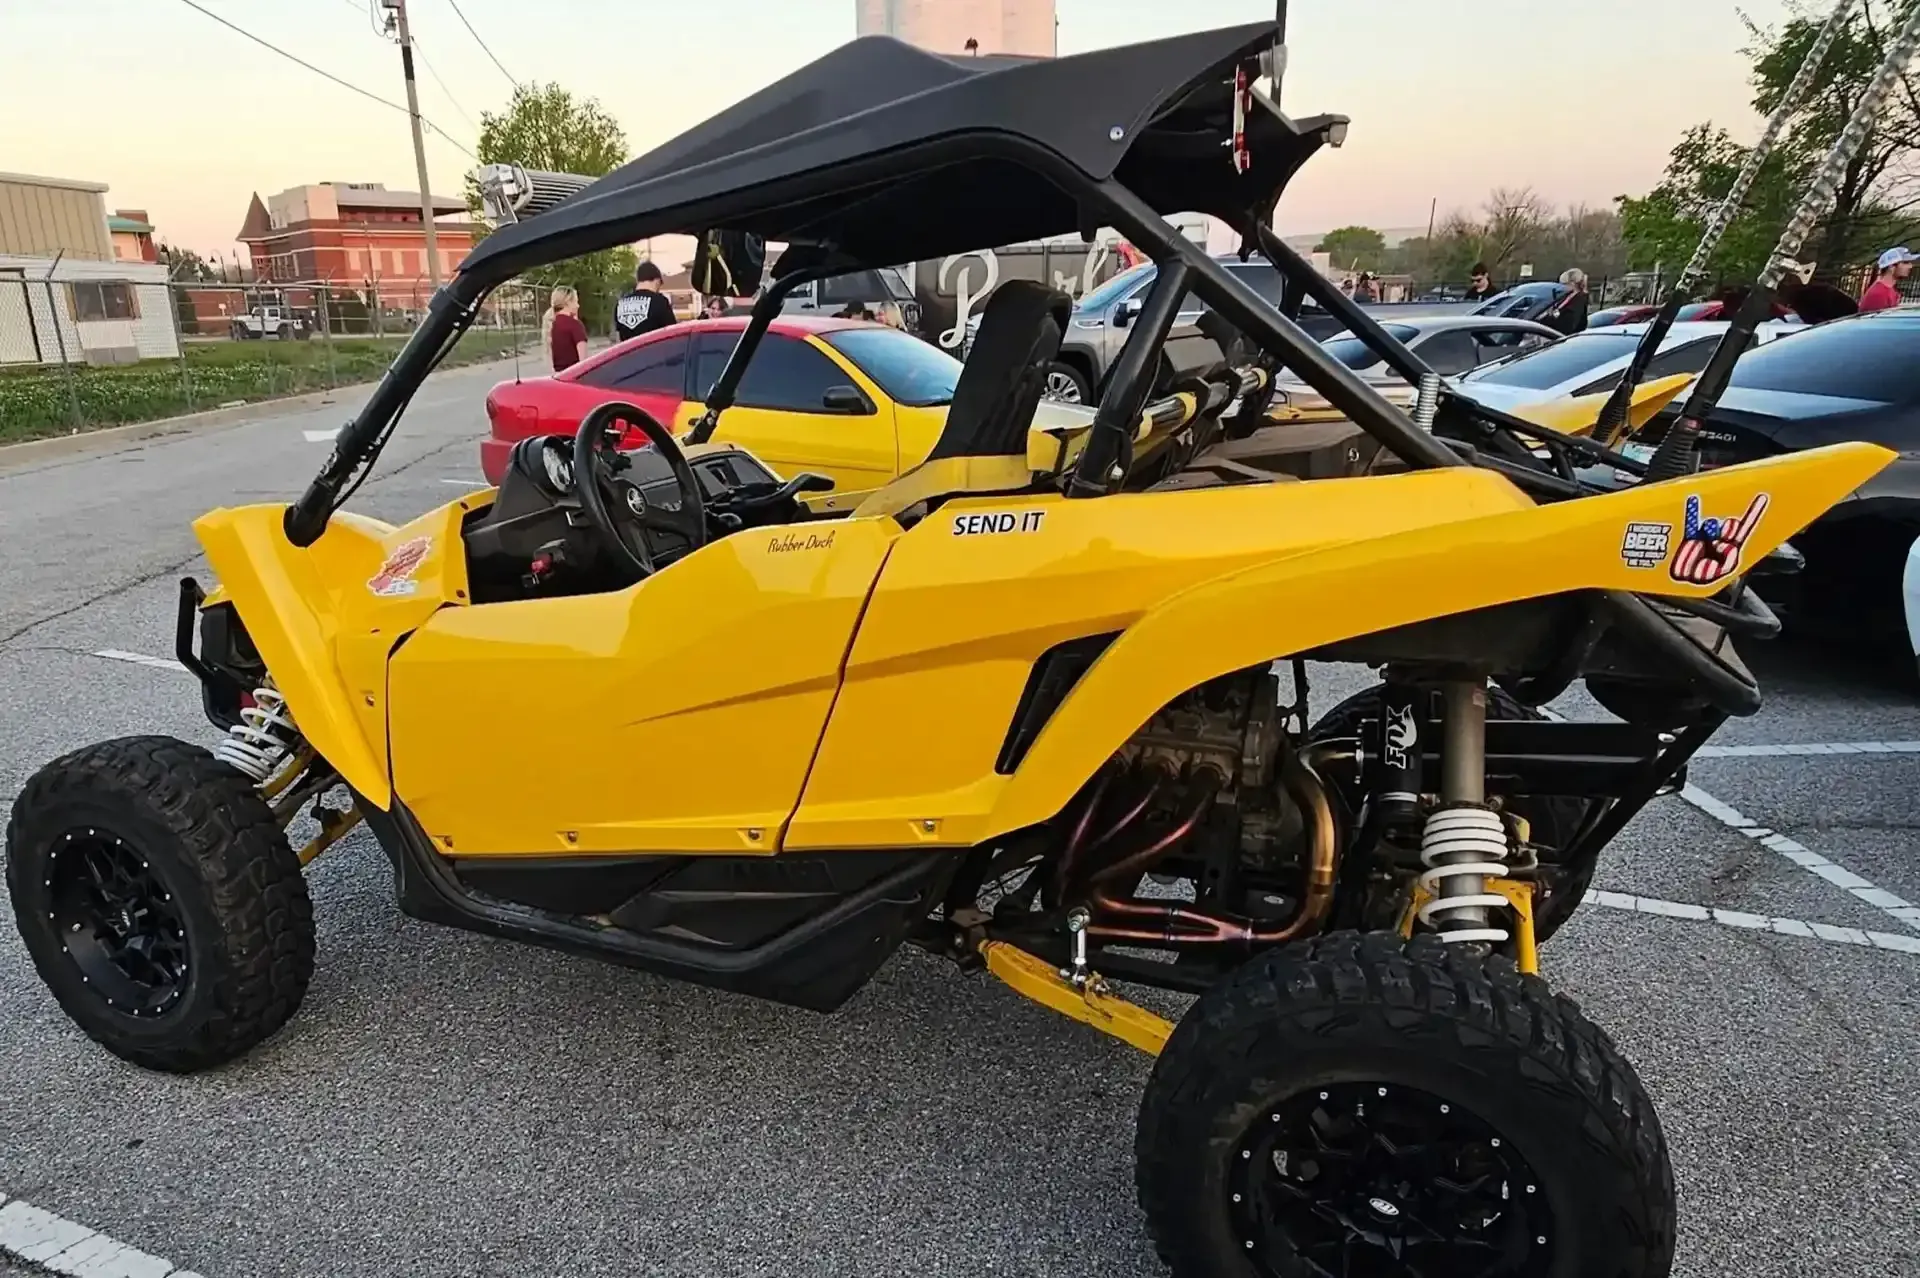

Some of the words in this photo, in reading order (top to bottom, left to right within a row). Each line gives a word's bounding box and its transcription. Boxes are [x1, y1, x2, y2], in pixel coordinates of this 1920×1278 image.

[953, 513, 1016, 536] SEND
[1022, 511, 1045, 532] IT
[768, 533, 804, 554] Rubber
[805, 529, 836, 550] Duck
[1624, 532, 1668, 551] BEER
[1385, 704, 1417, 769] FOX
